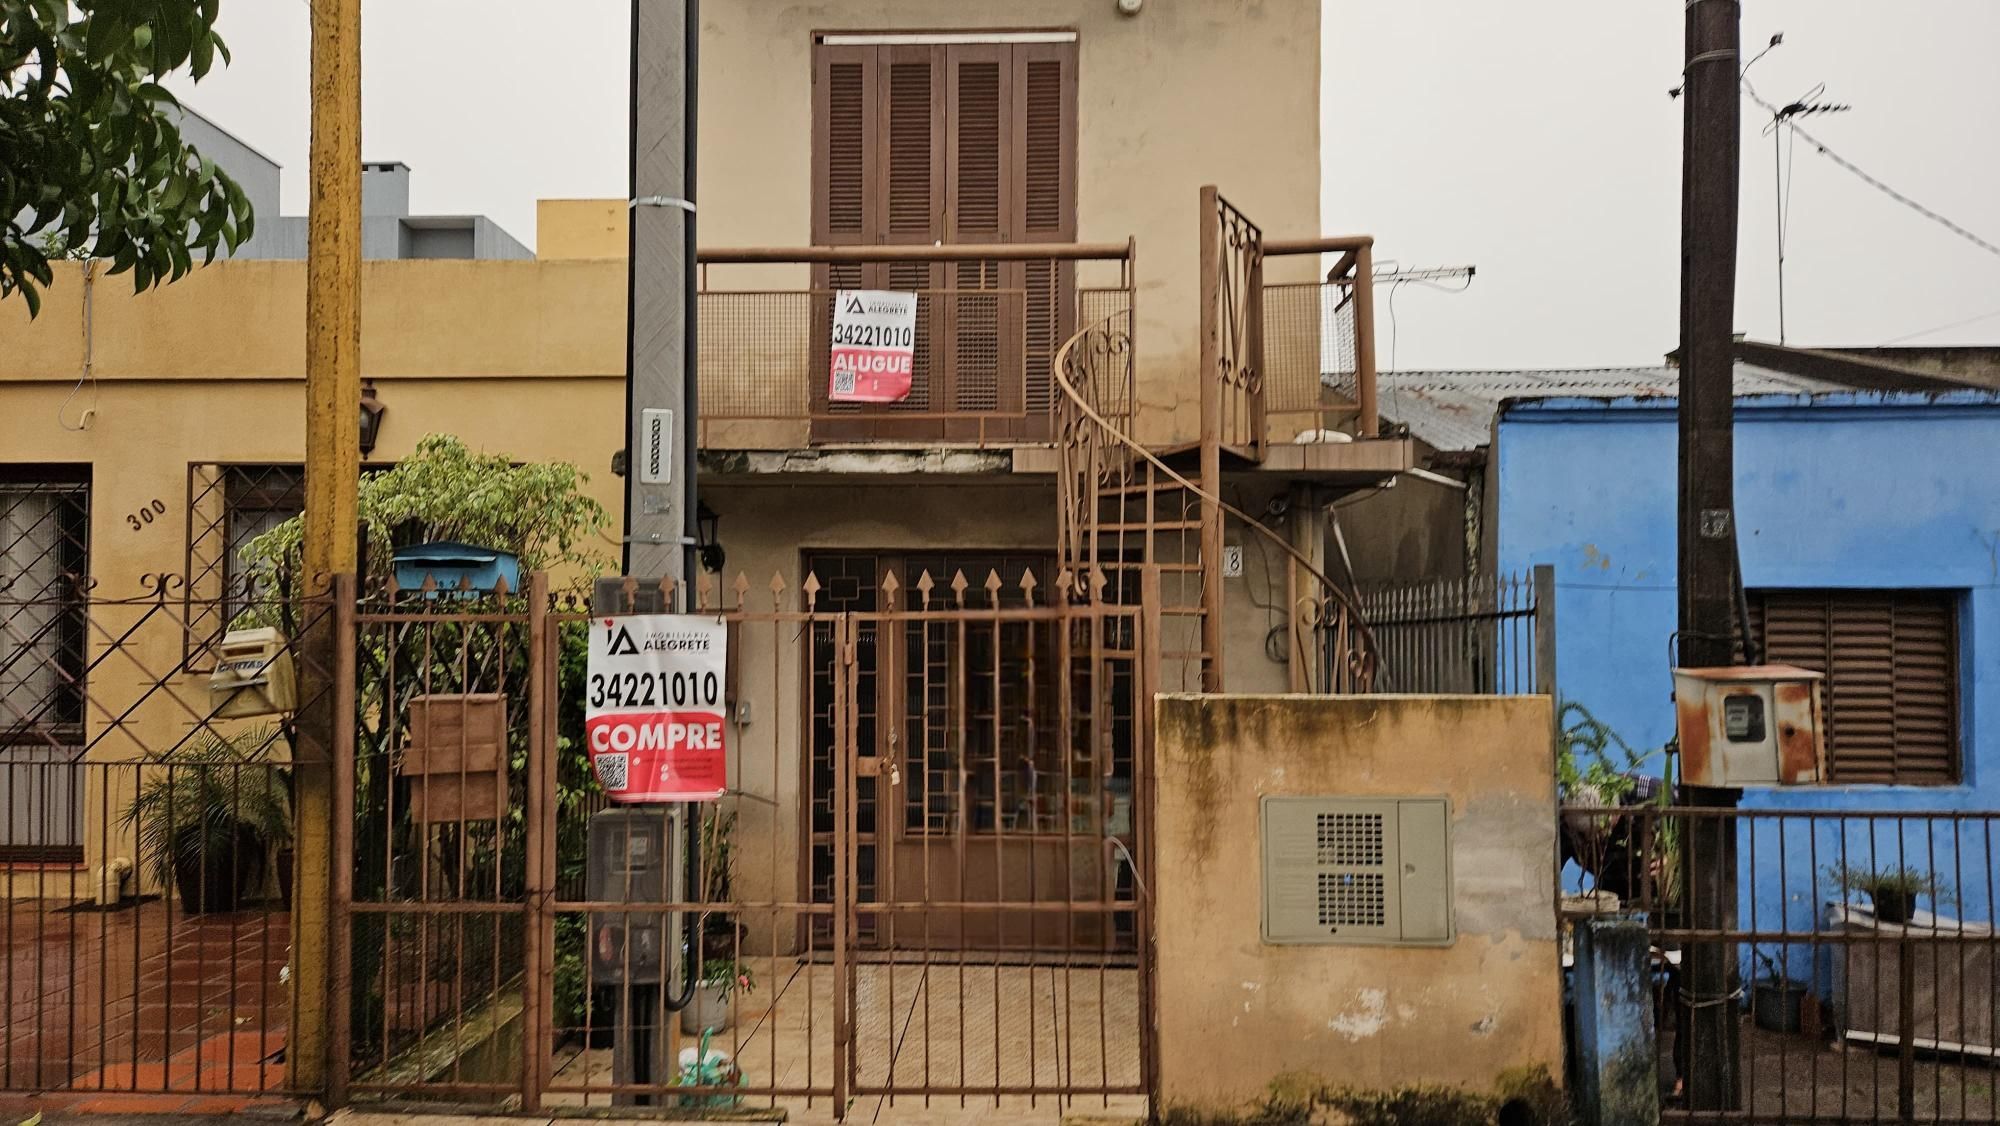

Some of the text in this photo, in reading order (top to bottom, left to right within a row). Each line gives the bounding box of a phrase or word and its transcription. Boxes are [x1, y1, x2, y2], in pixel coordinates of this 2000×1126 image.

[834, 324, 911, 347] 34221010
[834, 353, 911, 374] ALUGUE
[127, 499, 165, 531] 300
[643, 639, 710, 651] ALEGRETE
[591, 671, 718, 708] 34221010
[591, 722, 722, 752] COMPRE
